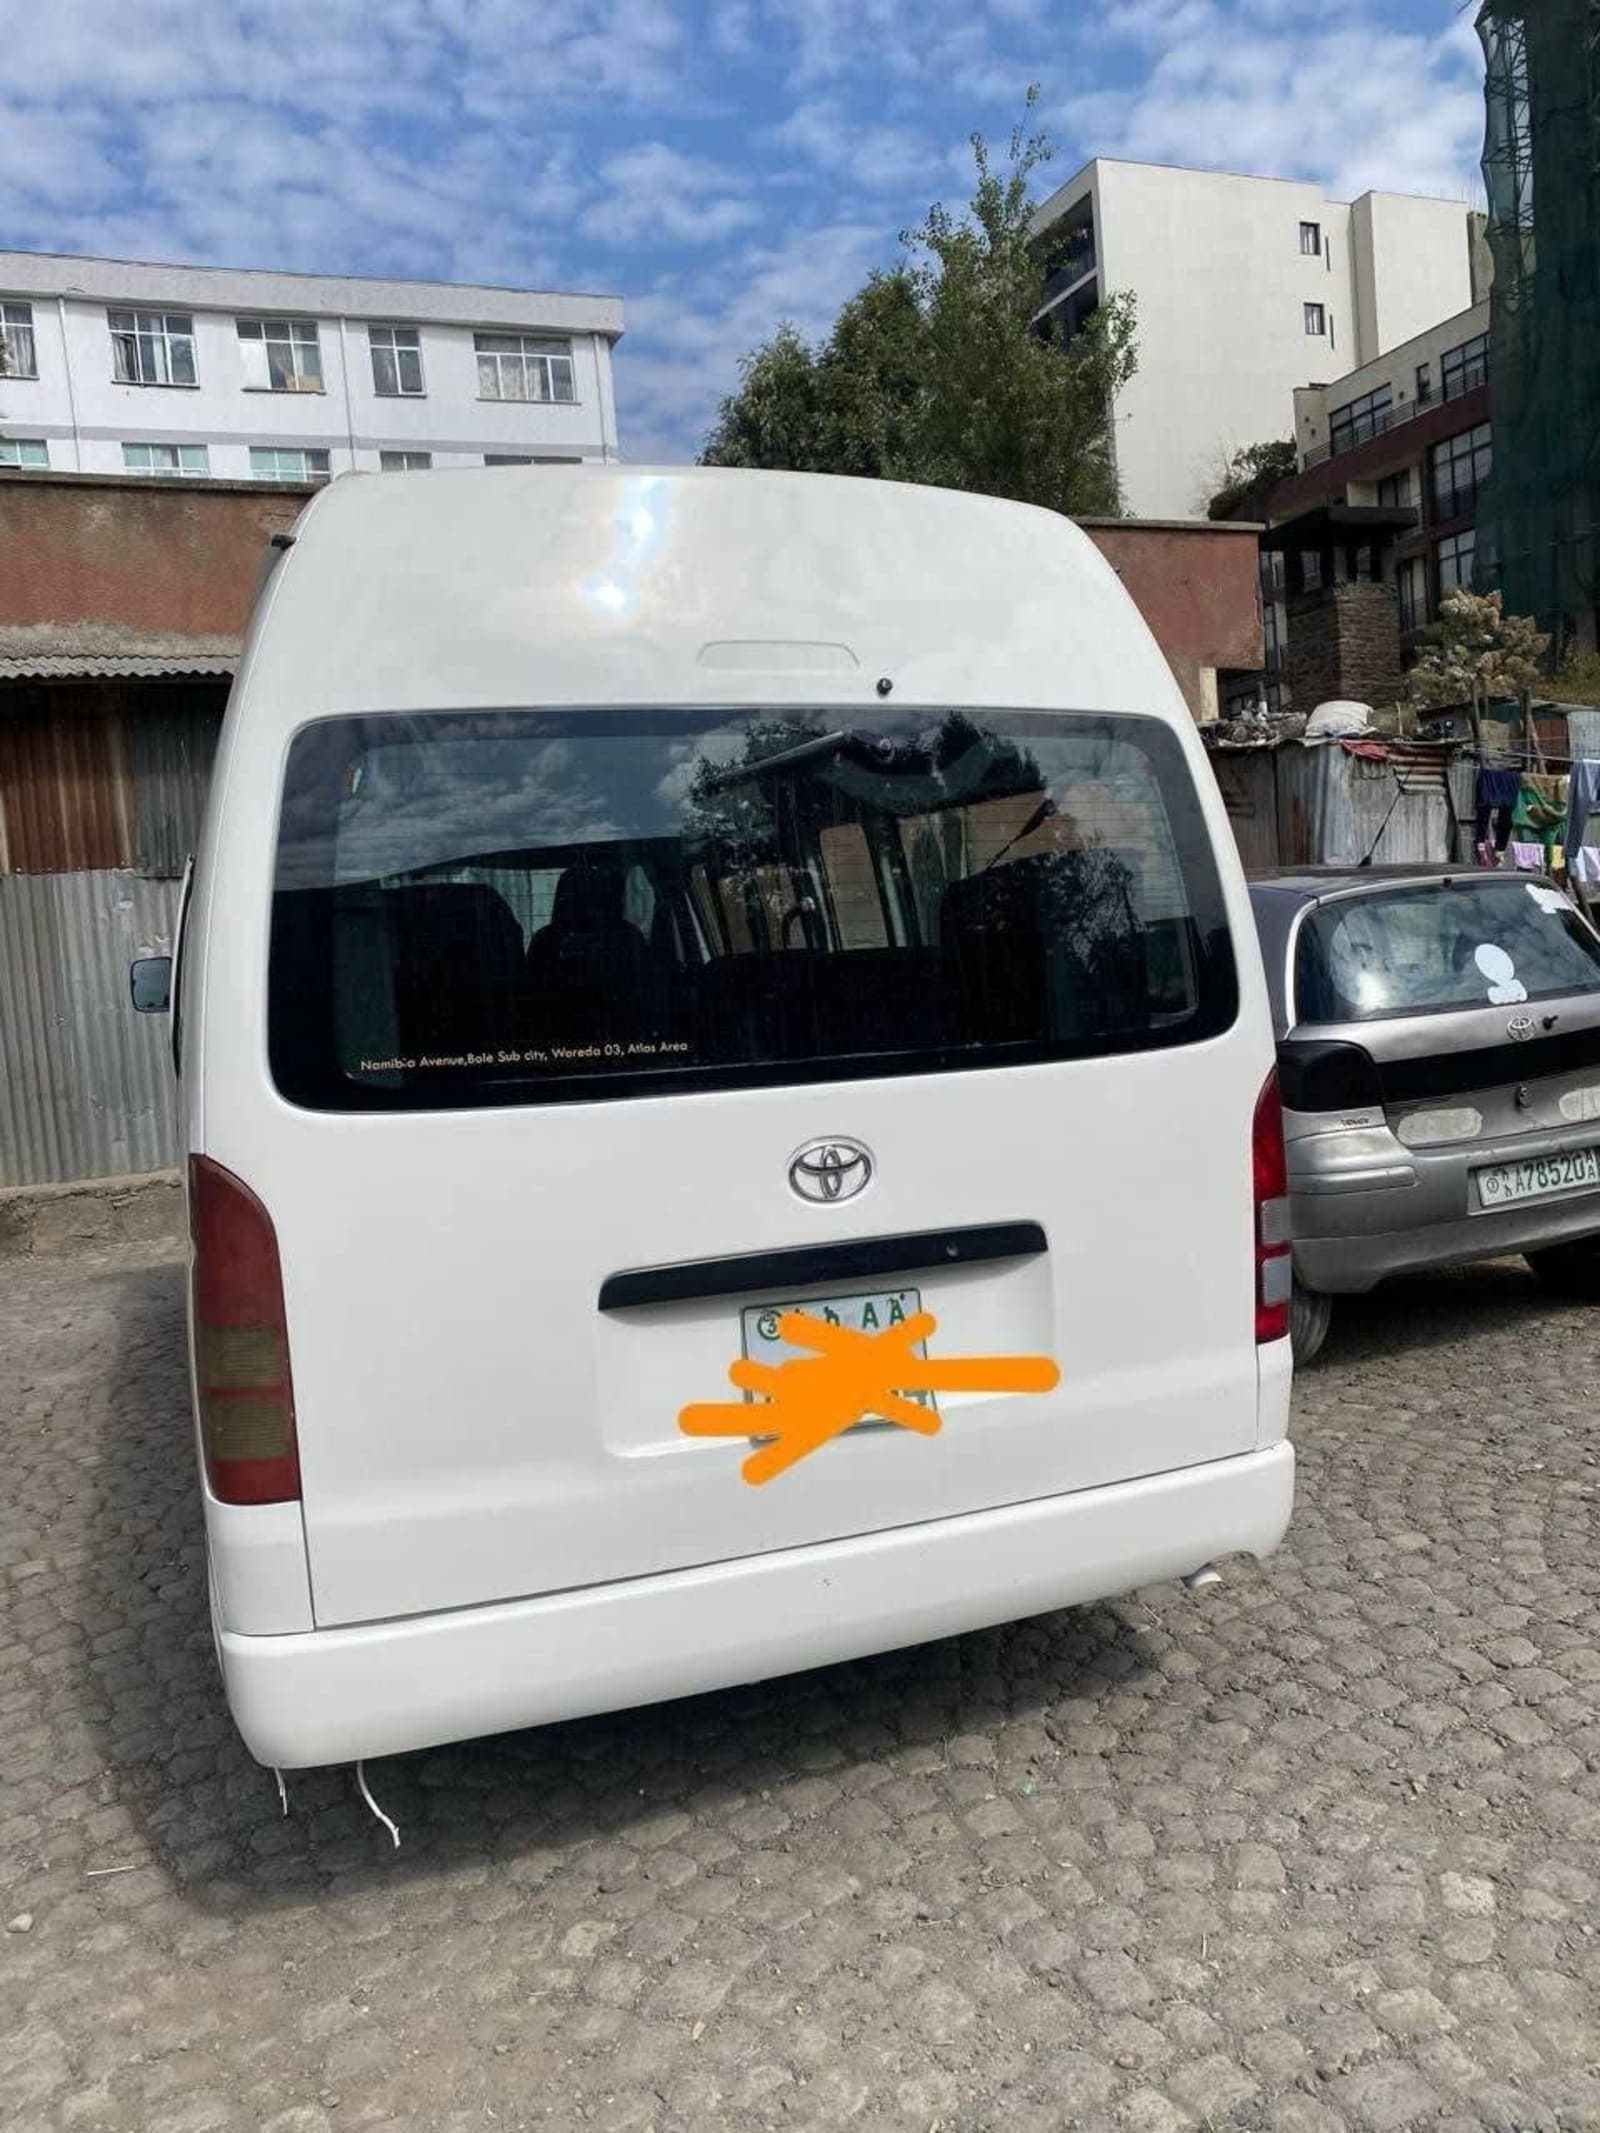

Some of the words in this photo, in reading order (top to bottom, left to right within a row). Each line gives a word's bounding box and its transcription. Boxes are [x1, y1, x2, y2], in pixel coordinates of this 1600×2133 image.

[497, 1050, 521, 1063] Sub
[524, 1048, 548, 1062] city,
[551, 1046, 601, 1059] Woreda
[604, 1043, 625, 1057] 03,
[627, 1042, 656, 1055] Atlas
[659, 1041, 688, 1053] Area
